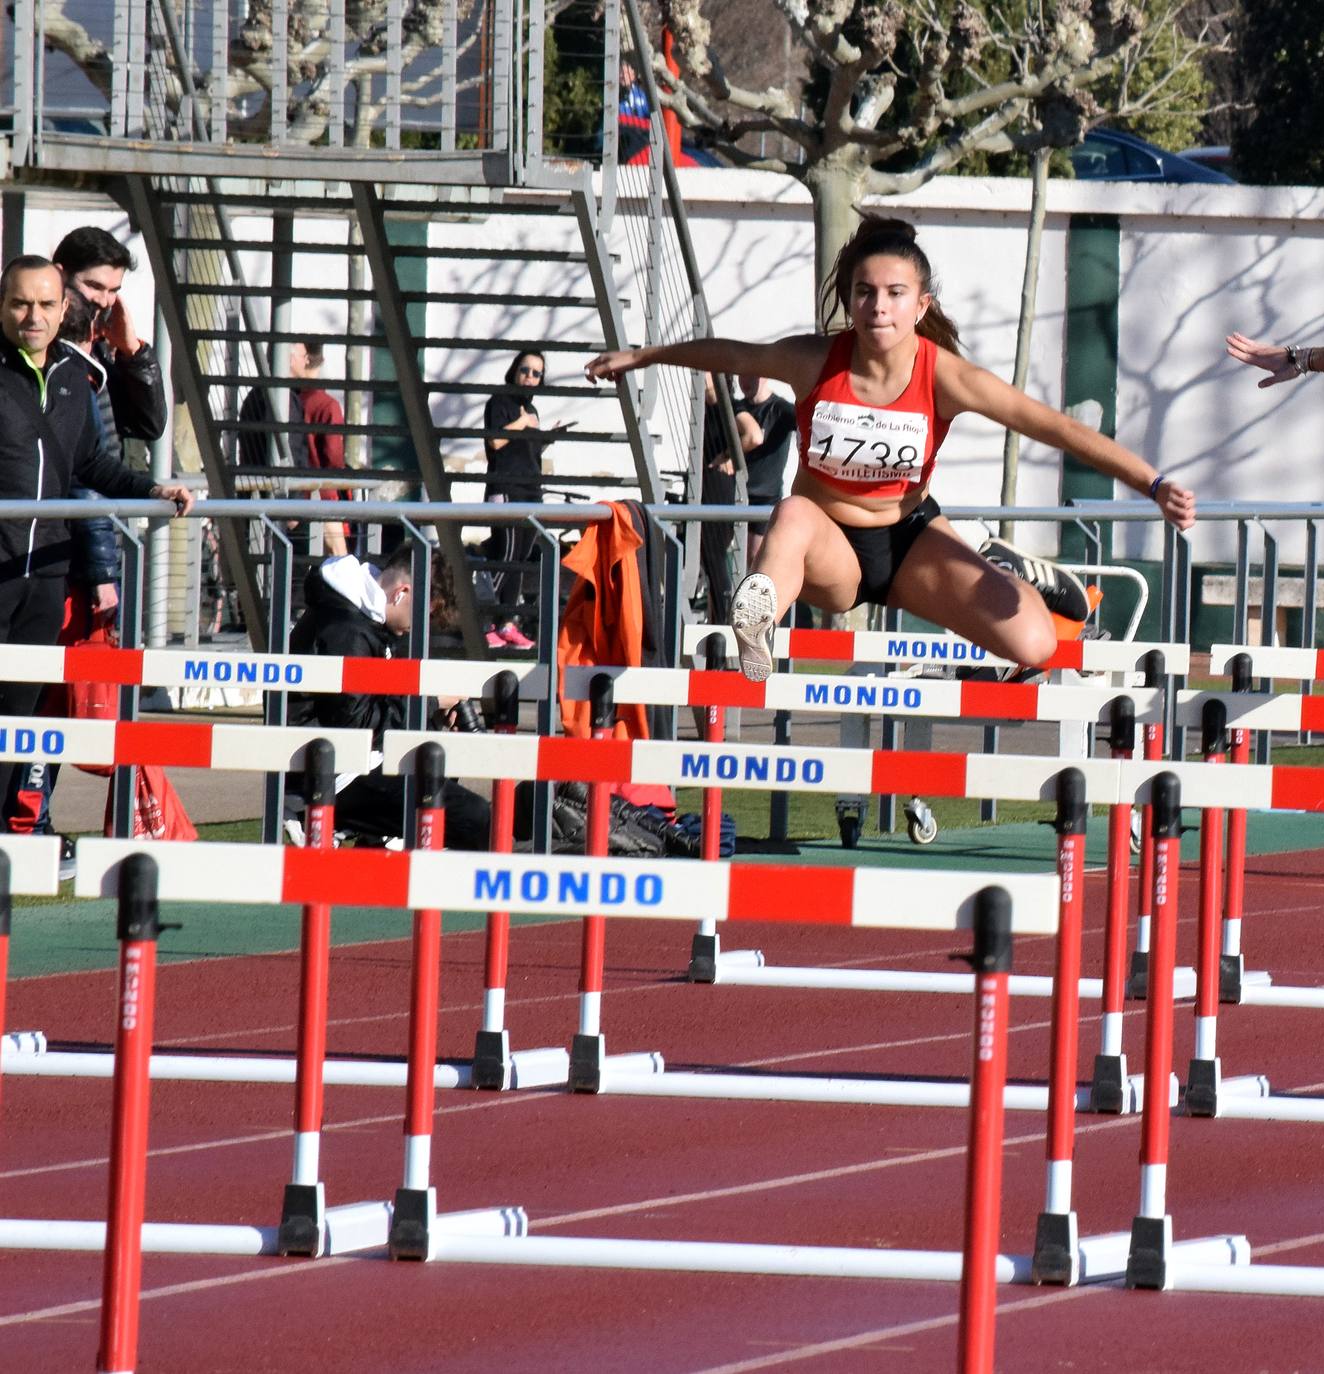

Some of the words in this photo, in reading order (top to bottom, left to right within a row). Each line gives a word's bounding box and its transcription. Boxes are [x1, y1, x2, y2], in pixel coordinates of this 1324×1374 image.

[815, 411, 855, 426] Gobierno
[876, 420, 887, 429] de
[889, 422, 901, 431] La
[818, 434, 918, 471] 1738
[887, 639, 987, 661] MONDO
[184, 659, 304, 685] MONDO
[804, 683, 922, 709] MONDO
[681, 753, 825, 785] MONDO
[473, 868, 664, 907] MONDO
